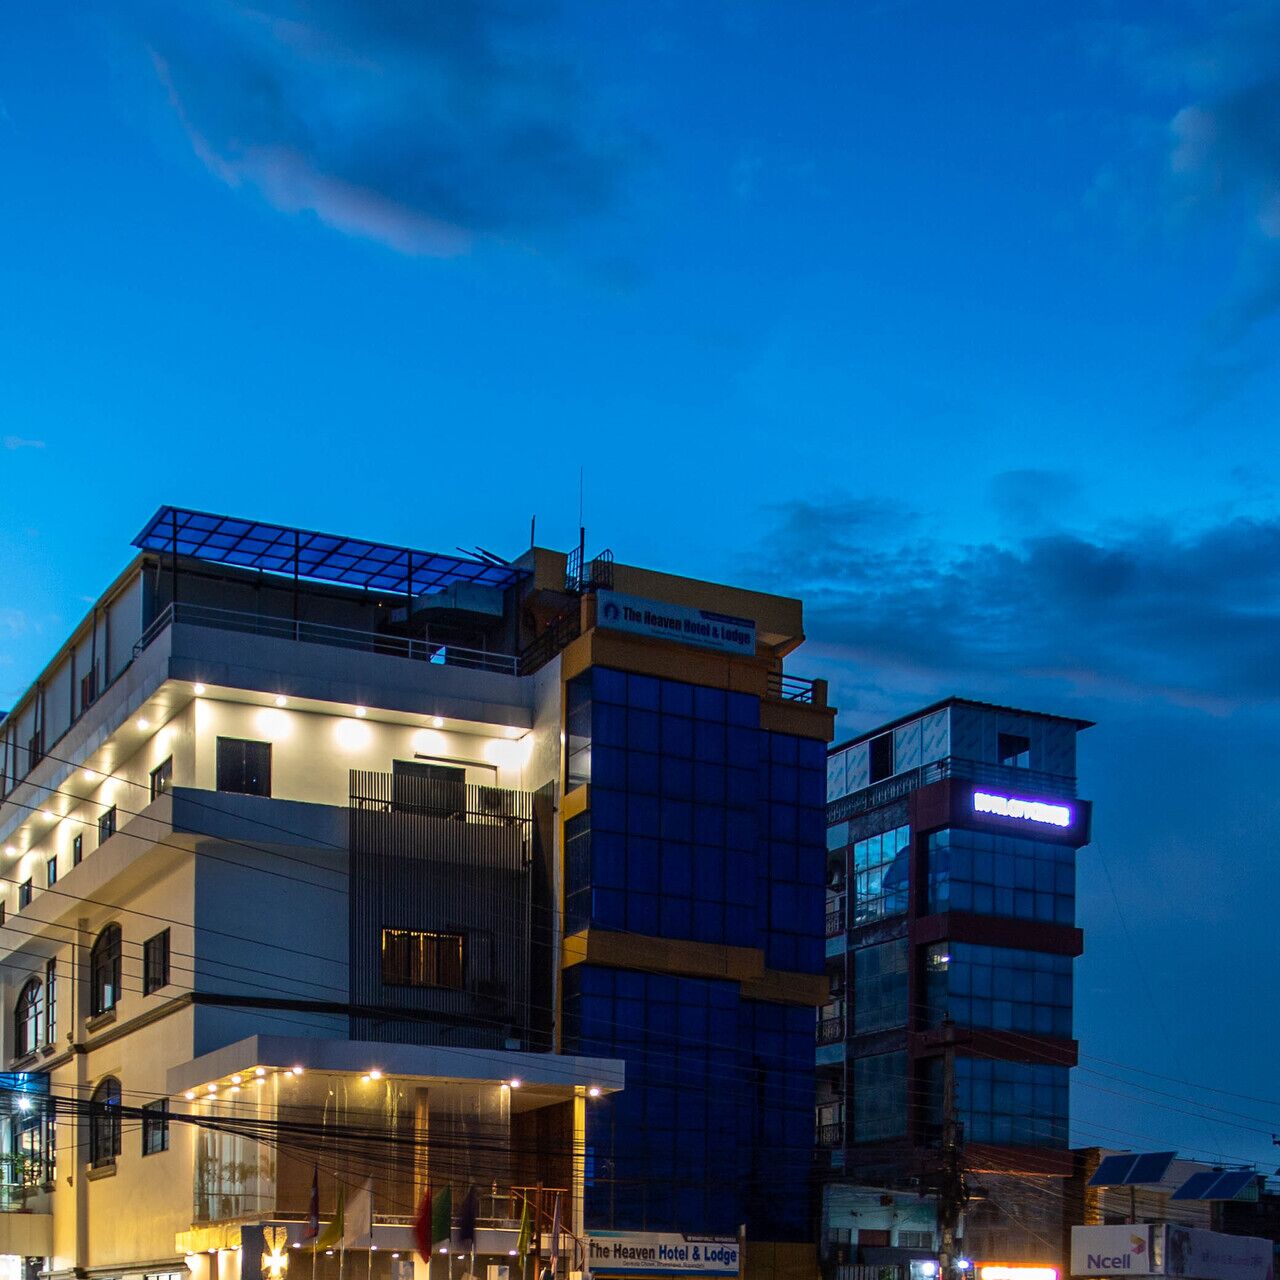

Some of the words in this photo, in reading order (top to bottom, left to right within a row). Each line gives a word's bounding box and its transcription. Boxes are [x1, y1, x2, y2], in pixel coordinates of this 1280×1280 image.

[623, 606, 642, 623] The
[644, 611, 682, 631] Heaven
[684, 619, 710, 636] Hotel
[711, 626, 720, 639] &
[721, 626, 751, 645] Lodge
[589, 1241, 610, 1259] The
[613, 1243, 655, 1260] Heaven
[658, 1244, 688, 1261] Hotel
[692, 1246, 701, 1261] &
[704, 1246, 737, 1265] Lodge
[1087, 1254, 1131, 1269] Ncell
